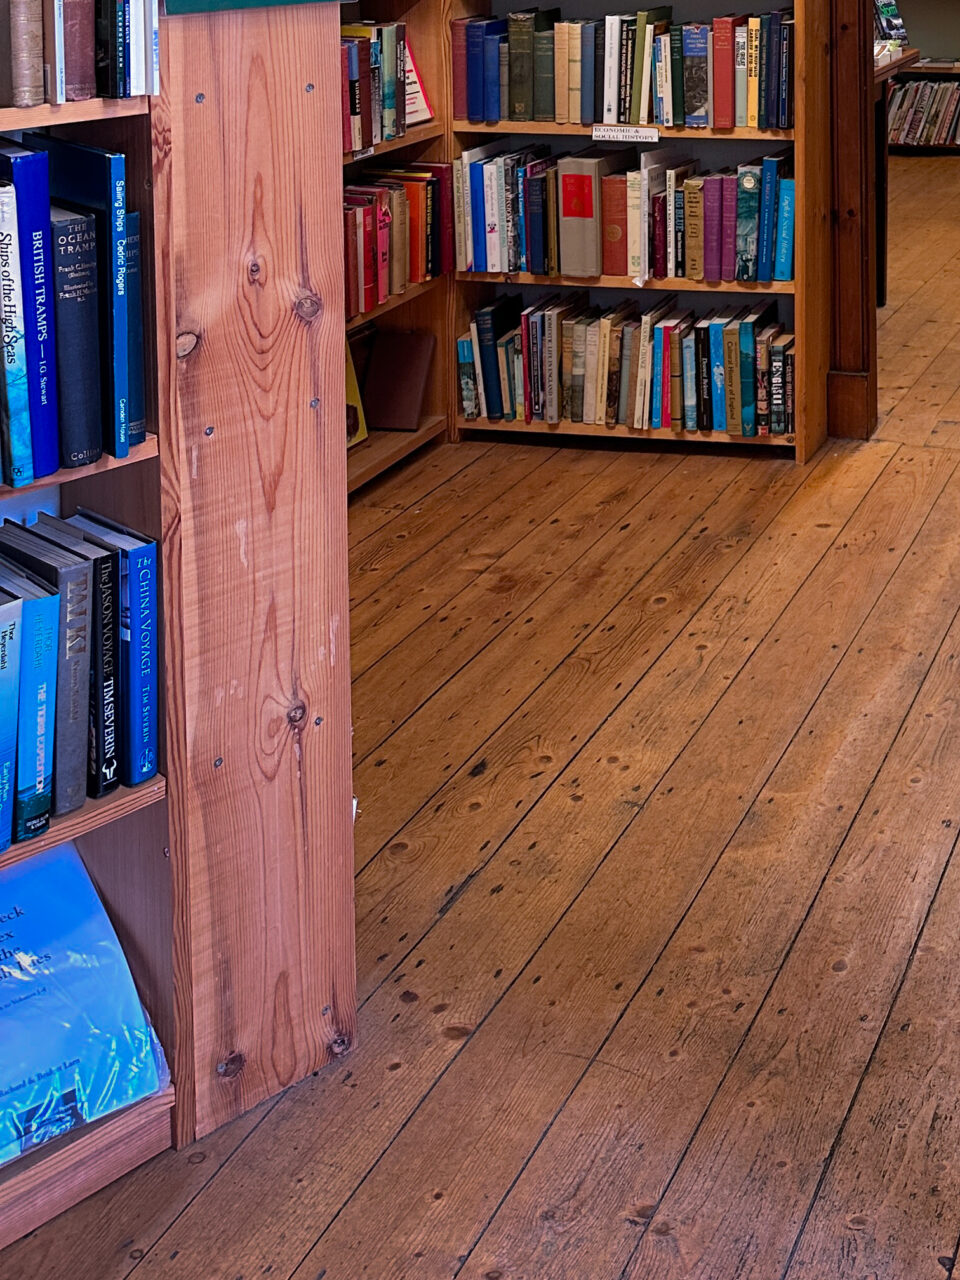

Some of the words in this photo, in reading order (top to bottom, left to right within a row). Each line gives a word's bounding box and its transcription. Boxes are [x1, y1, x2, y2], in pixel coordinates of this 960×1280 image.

[115, 180, 125, 206] Sailing
[116, 208, 124, 231] Ships
[0, 232, 12, 267] Ships
[58, 232, 95, 244] OCEAN
[59, 242, 95, 254] TRAMP
[32, 231, 44, 283] BRITISH
[117, 239, 125, 266] Cedric
[2, 270, 14, 282] of
[117, 268, 125, 296] Rogers
[2, 283, 15, 302] the
[1, 304, 16, 333] High
[36, 286, 47, 341] TRAMPS
[3, 335, 17, 364] Seas
[137, 558, 152, 568] The
[139, 569, 150, 617] CHINA
[140, 620, 151, 677] VOYAGE
[104, 676, 114, 704] TIM
[104, 703, 115, 758] SEVERIN
